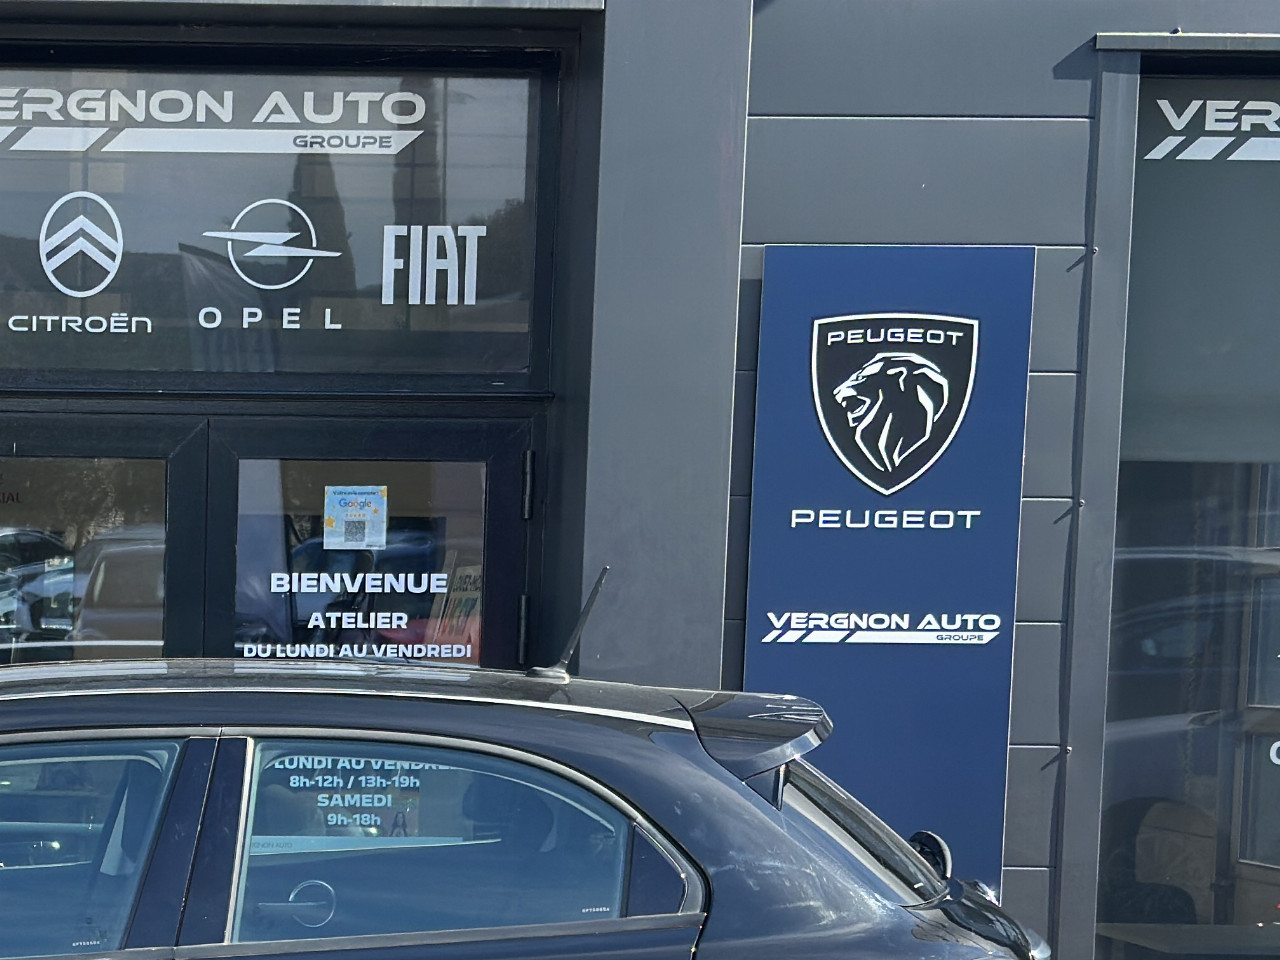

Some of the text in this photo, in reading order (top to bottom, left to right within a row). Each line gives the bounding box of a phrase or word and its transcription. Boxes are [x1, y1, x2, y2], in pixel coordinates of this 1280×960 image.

[252, 91, 426, 124] AUTO
[293, 135, 393, 149] GROUPE
[382, 225, 487, 305] FIAT
[198, 306, 343, 331] OPEL
[827, 328, 964, 346] PEUGEOT
[339, 498, 372, 510] Google
[791, 509, 981, 529] PEUGEOT
[270, 573, 448, 594] BIENVENUE
[307, 612, 408, 630] ATELIER
[767, 612, 1001, 632] VERGNON AUTO
[936, 634, 985, 643] GROUPE
[243, 644, 472, 659] DU LUNDI AU VENDREDI
[336, 758, 365, 770] AU
[289, 775, 344, 788] 8h-12h
[358, 776, 421, 788] 13h-19h
[317, 794, 393, 807] SAMEDI
[327, 813, 382, 826] 9h-18h
